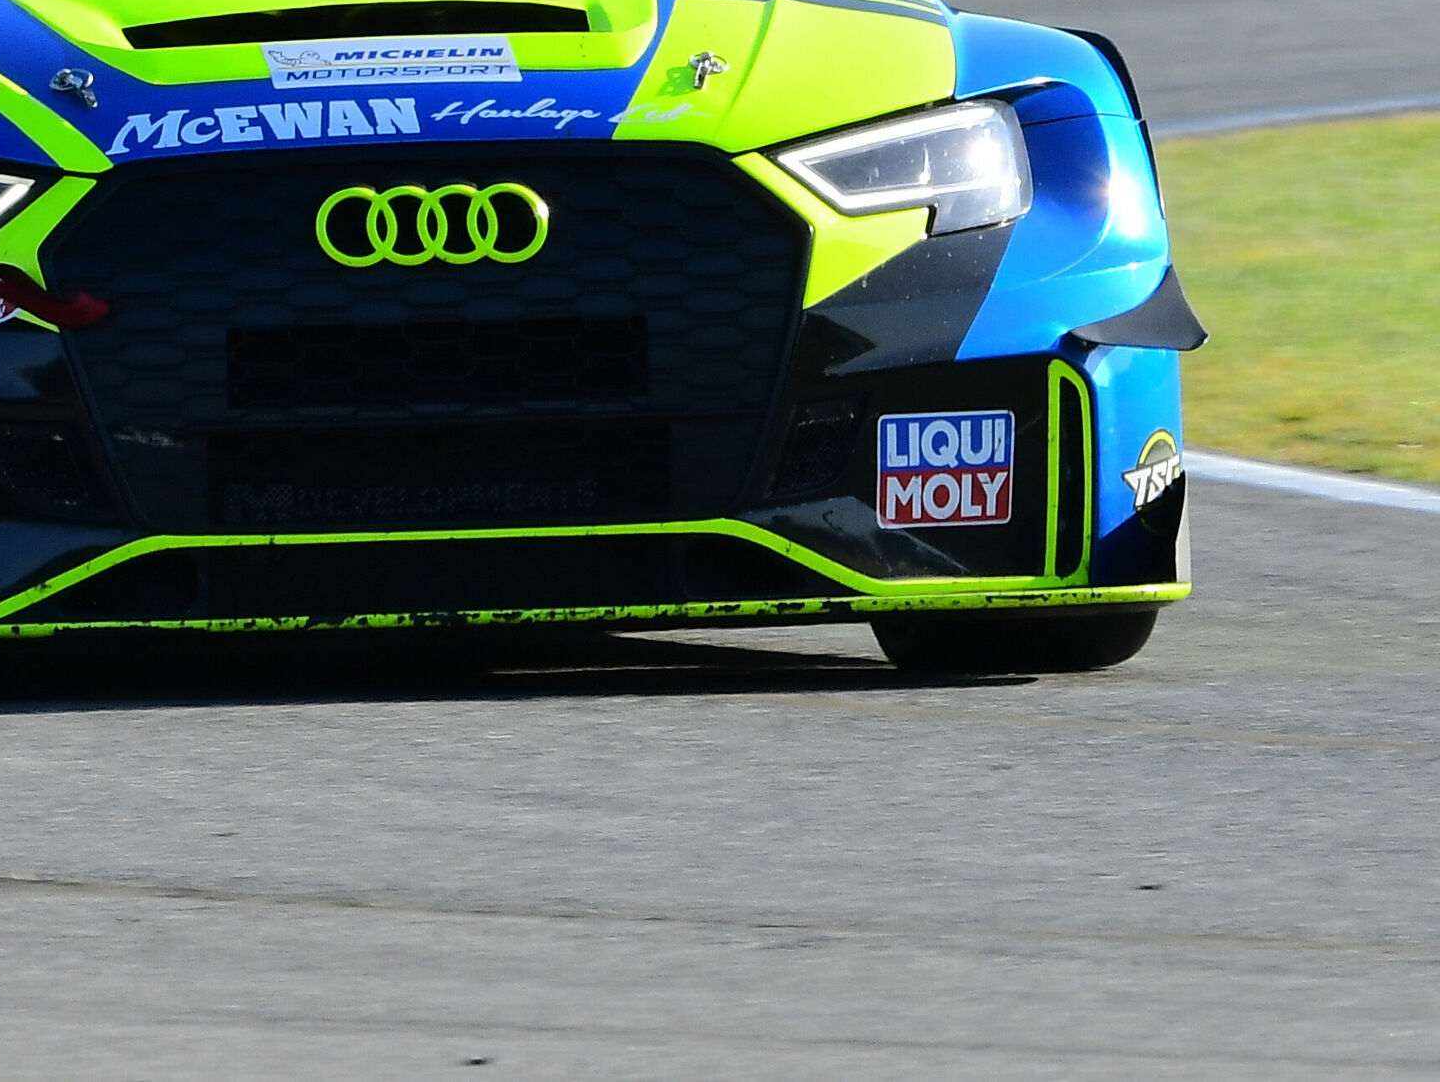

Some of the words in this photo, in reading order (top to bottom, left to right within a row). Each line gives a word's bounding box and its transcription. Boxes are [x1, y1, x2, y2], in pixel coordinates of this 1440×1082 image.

[286, 64, 512, 82] MOTORSPORT
[334, 47, 504, 62] MICHELIN
[105, 97, 422, 156] McEWAN
[430, 97, 602, 130] Haulage
[886, 418, 1006, 468] LIQUI
[886, 471, 1009, 520] MOLY
